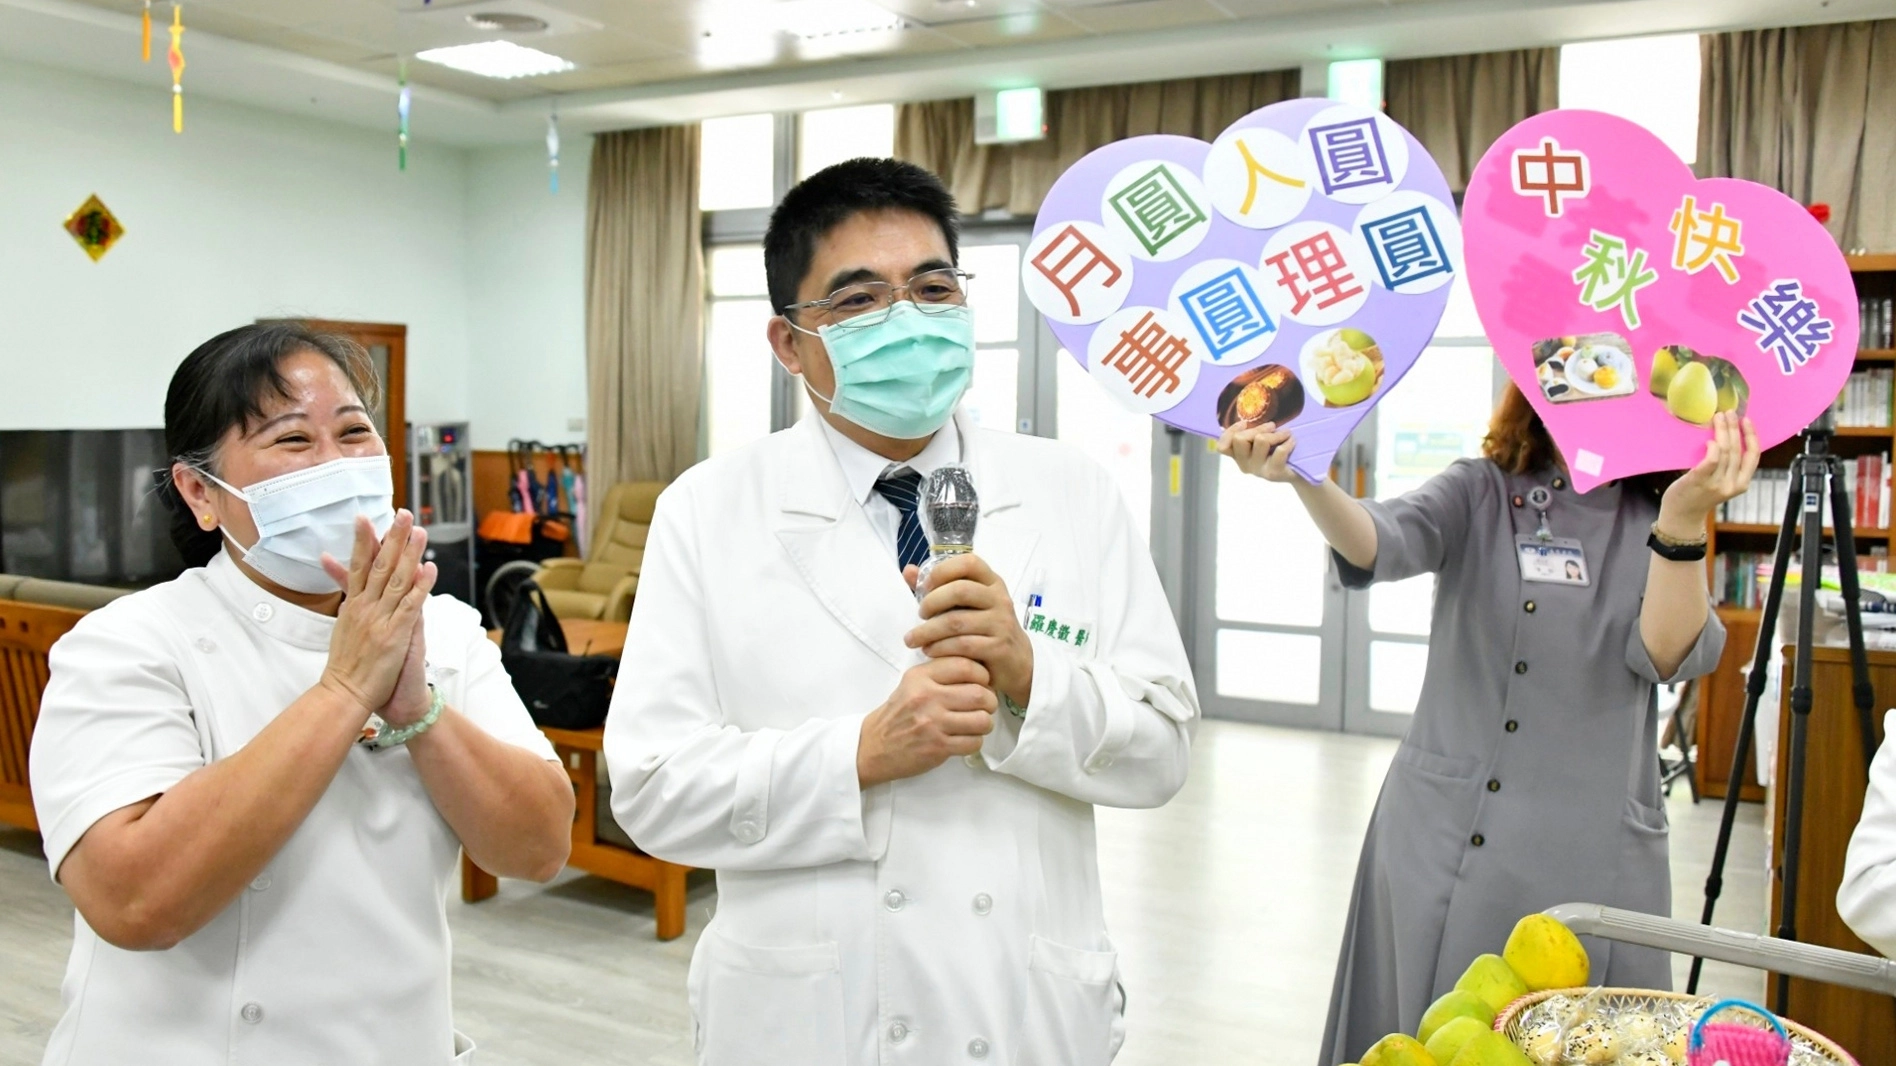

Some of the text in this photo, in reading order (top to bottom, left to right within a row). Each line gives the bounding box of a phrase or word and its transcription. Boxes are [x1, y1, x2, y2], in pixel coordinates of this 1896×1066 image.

[1031, 117, 1393, 317] 月圓人圓
[1101, 205, 1453, 399] 事圓理圓
